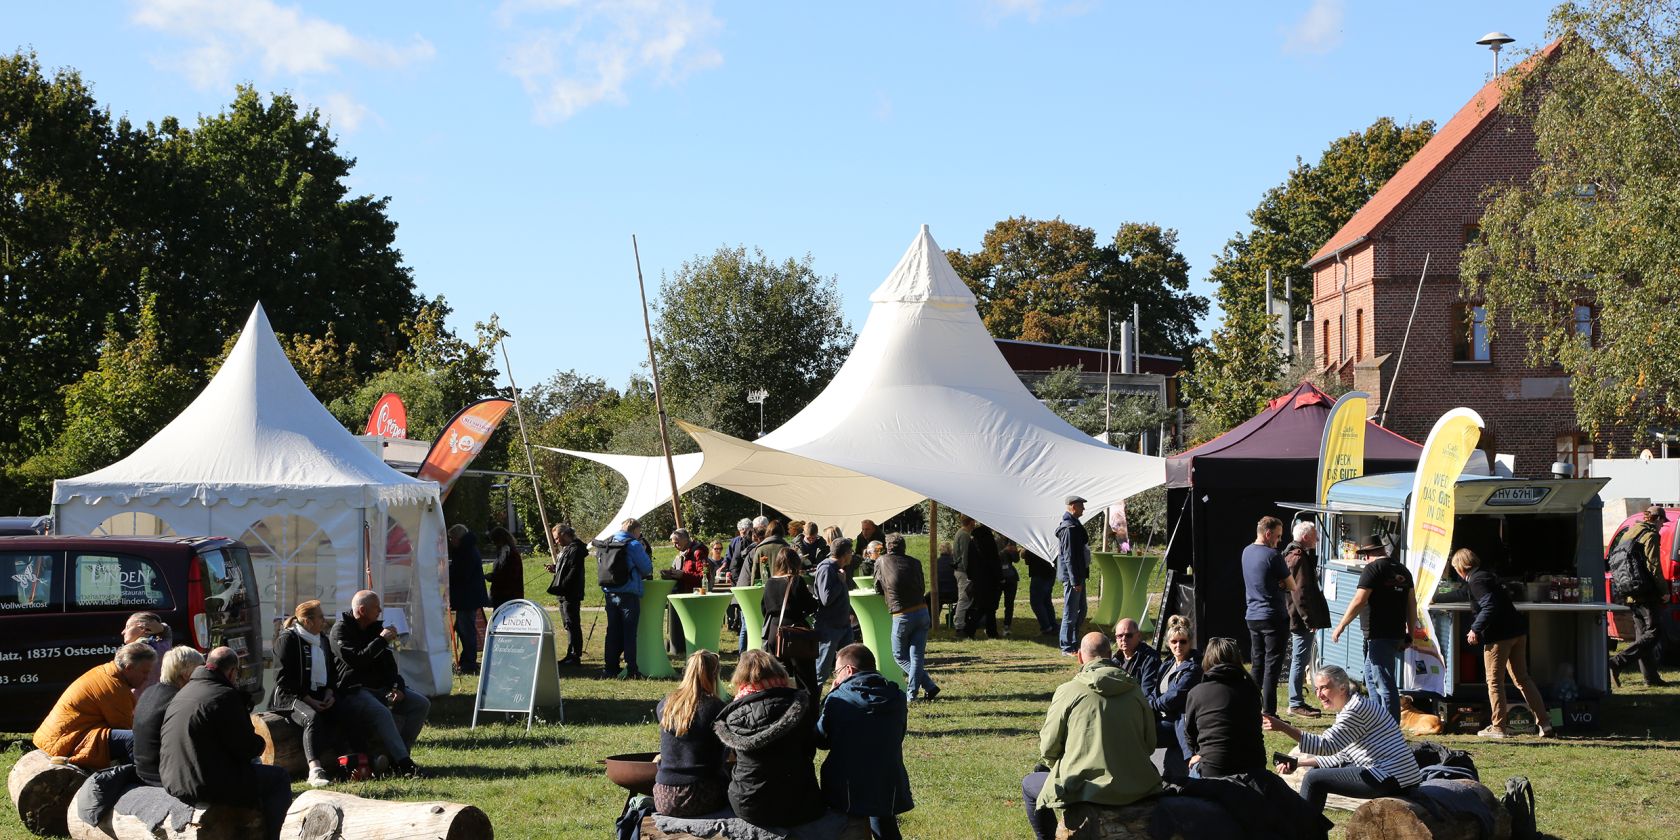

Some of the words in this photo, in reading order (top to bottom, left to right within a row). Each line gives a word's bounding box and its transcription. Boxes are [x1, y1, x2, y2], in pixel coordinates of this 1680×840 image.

[1339, 469, 1358, 480] GUTE
[1423, 486, 1437, 502] DAS
[91, 564, 150, 585] LINDEN
[0, 601, 48, 610] Vollwertkost
[78, 597, 158, 606] www.haus-linden.de
[502, 616, 532, 626] LINDEN
[27, 647, 61, 659] 18375
[20, 674, 39, 683] 636
[1571, 712, 1592, 722] ViO
